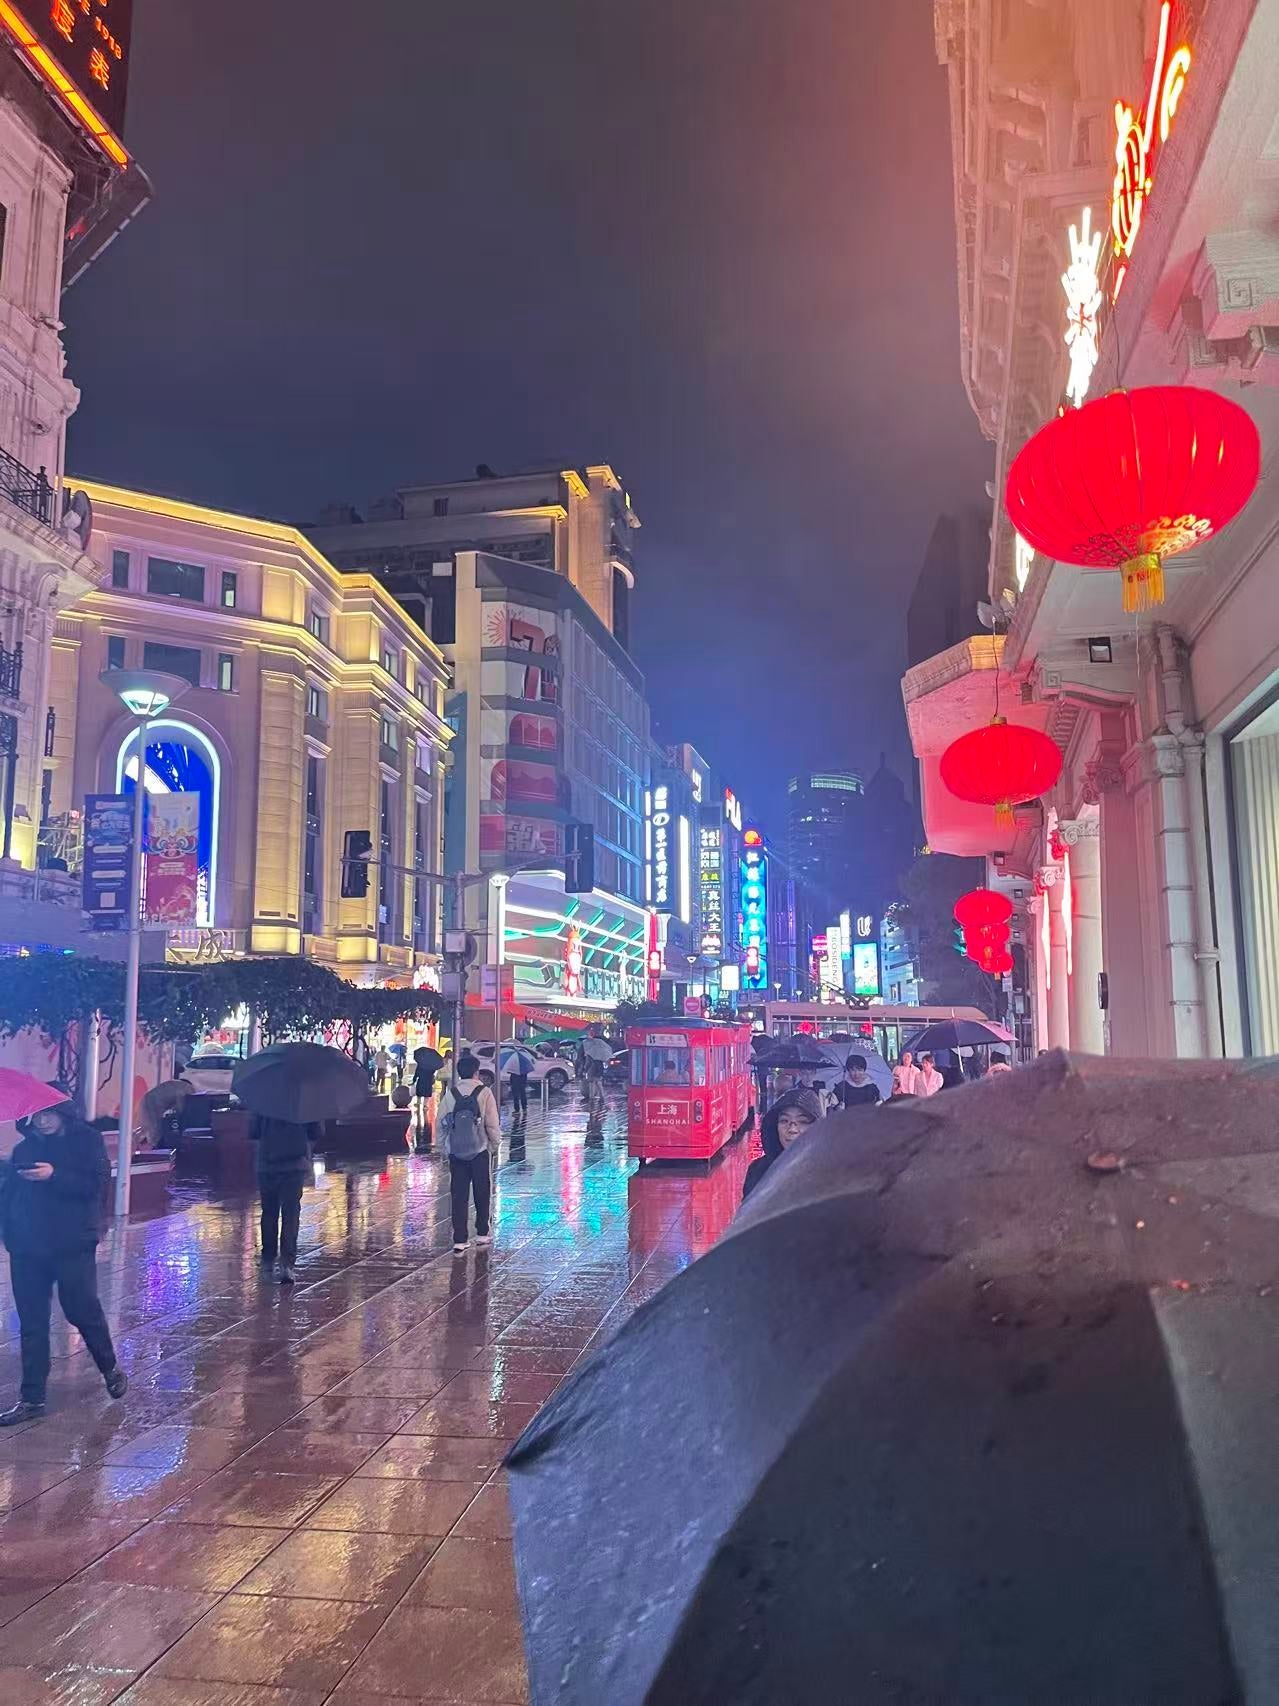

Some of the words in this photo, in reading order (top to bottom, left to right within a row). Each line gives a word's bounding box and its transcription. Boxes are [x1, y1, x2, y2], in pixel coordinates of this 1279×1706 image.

[707, 890, 721, 932] 真丝大王
[657, 1104, 678, 1115] 上海
